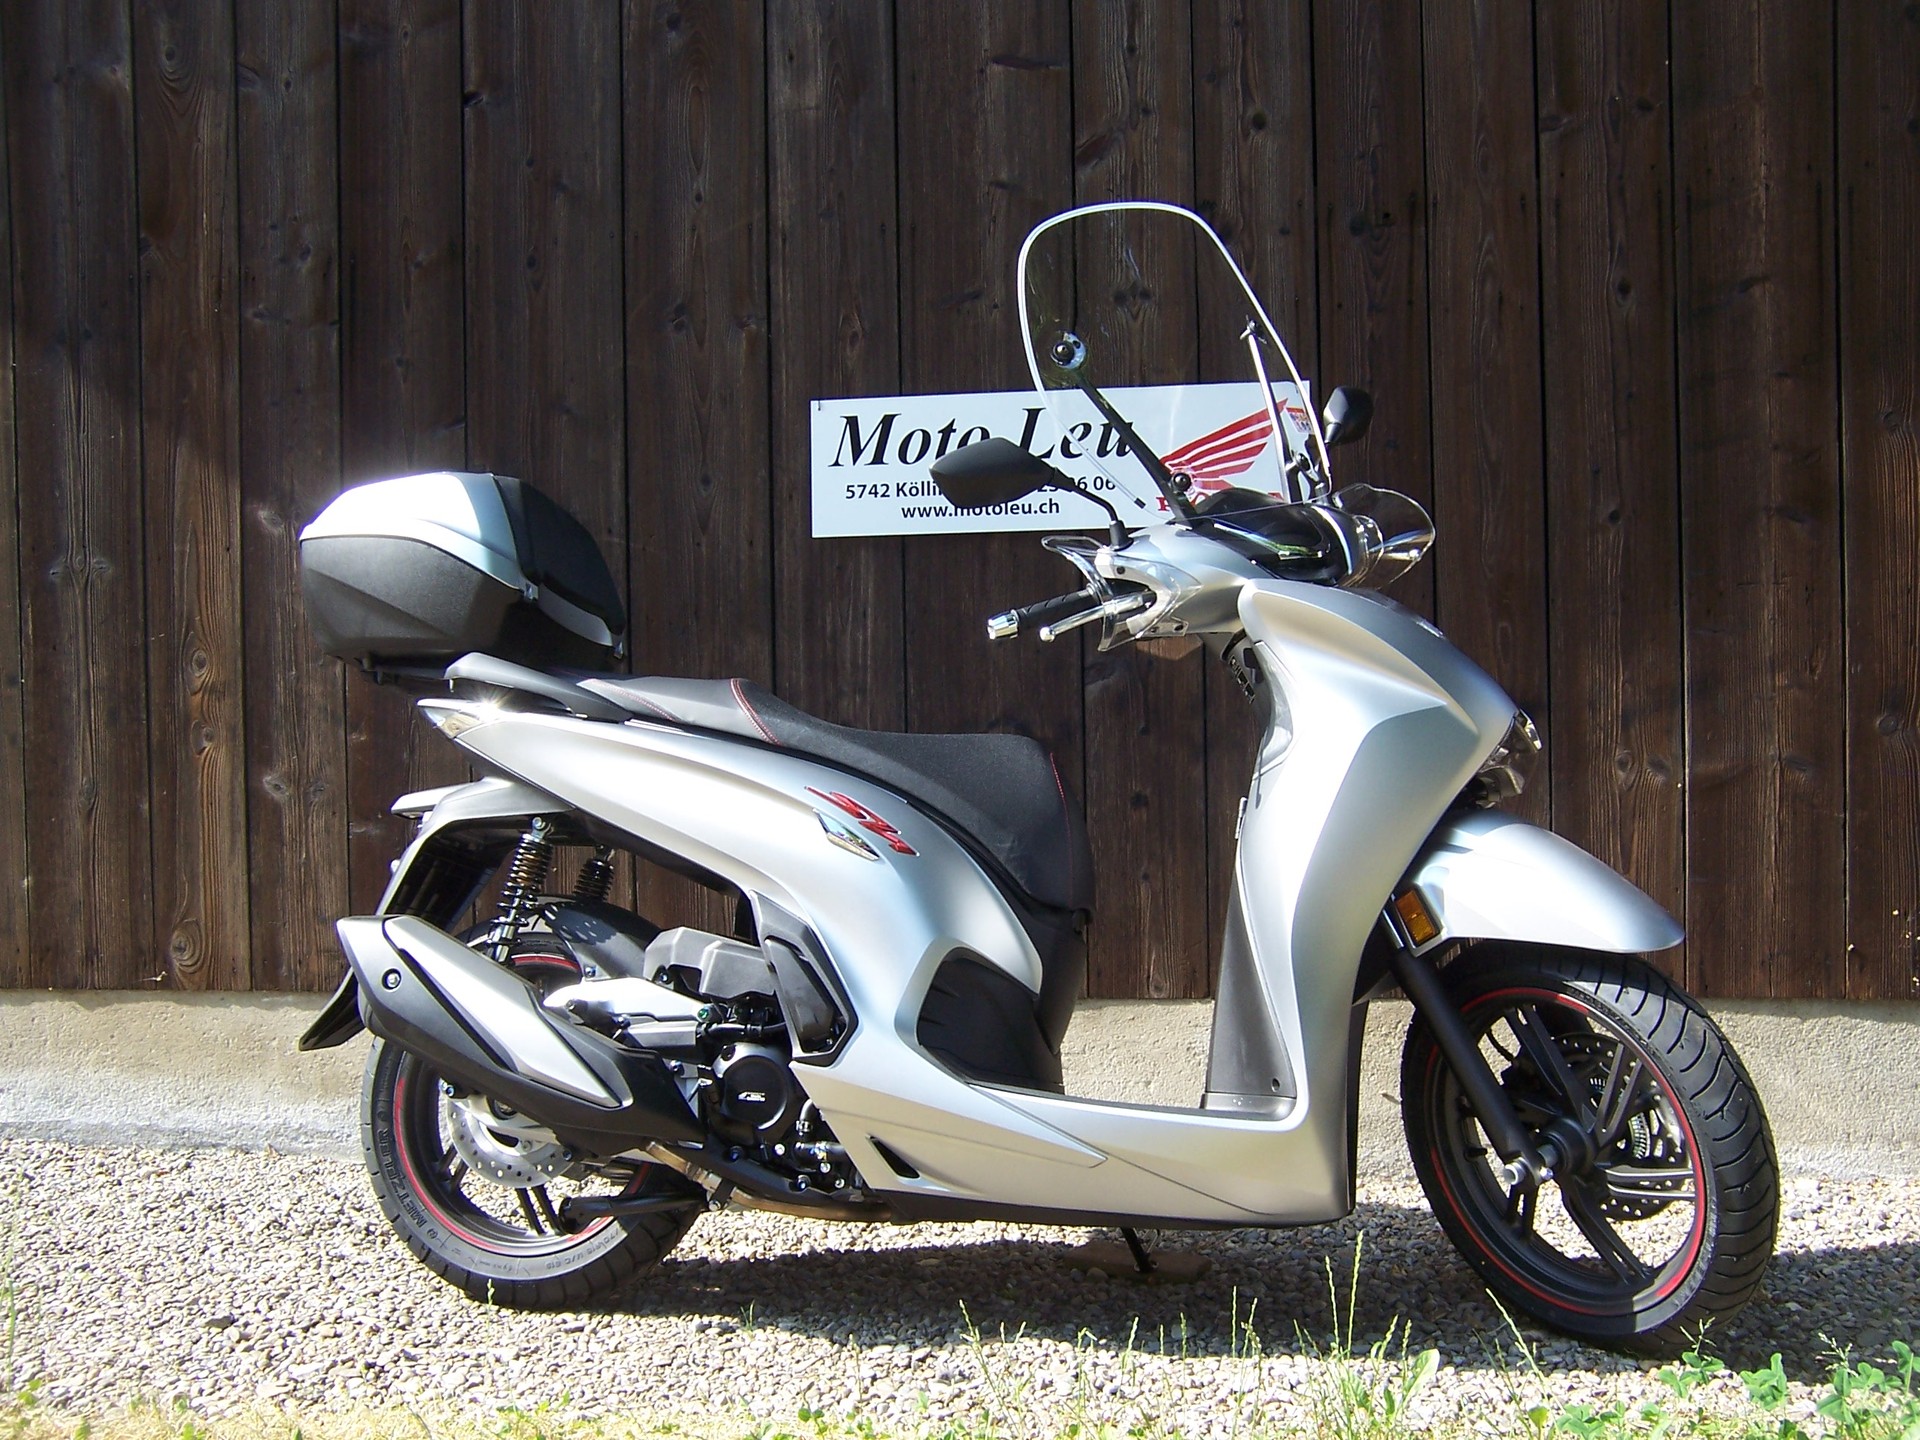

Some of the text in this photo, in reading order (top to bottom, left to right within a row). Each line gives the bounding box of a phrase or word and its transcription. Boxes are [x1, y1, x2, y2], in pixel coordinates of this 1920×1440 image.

[1021, 407, 1133, 459] Leu
[845, 483, 890, 499] 5742
[895, 480, 944, 497] Kölli
[901, 497, 1060, 518] www.motoleu.ch
